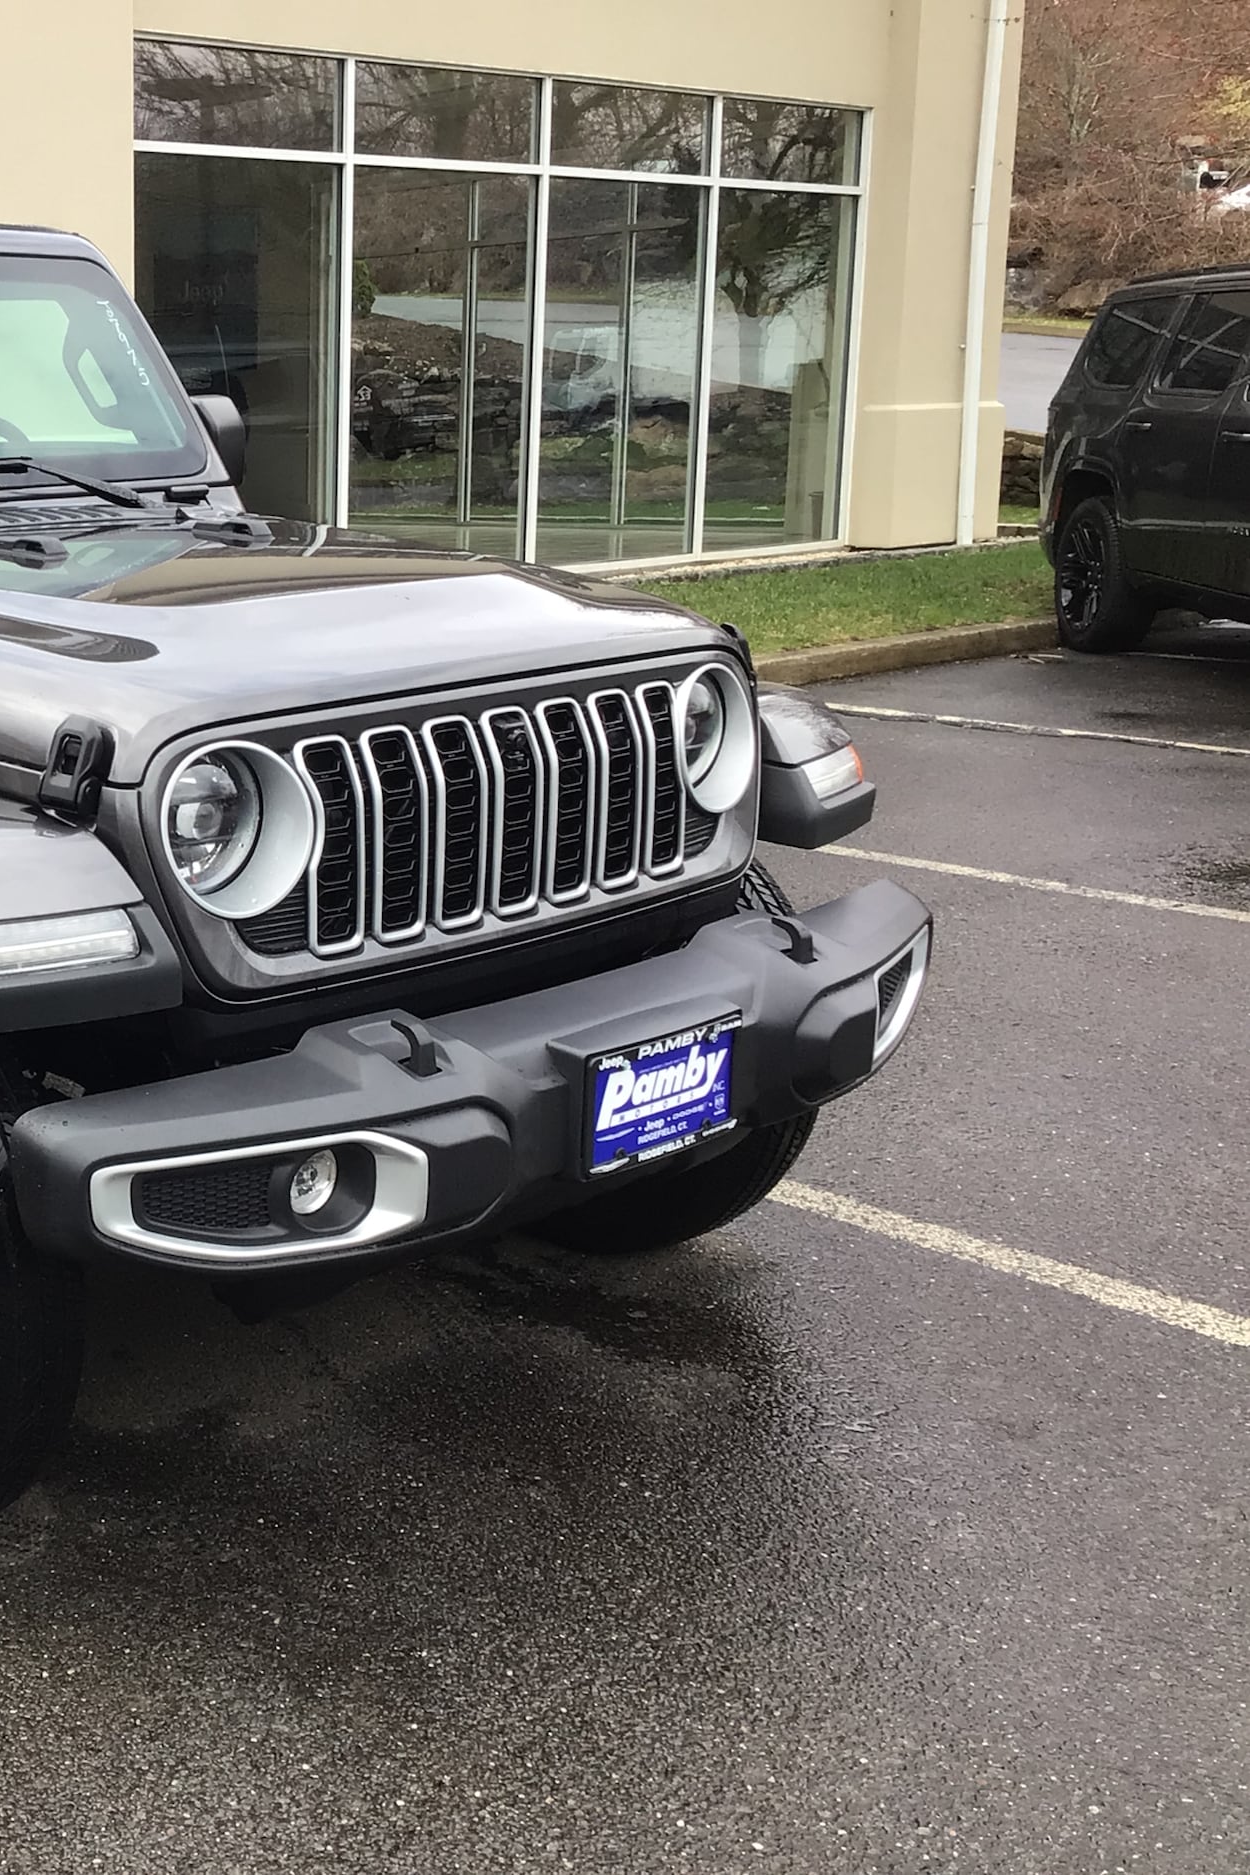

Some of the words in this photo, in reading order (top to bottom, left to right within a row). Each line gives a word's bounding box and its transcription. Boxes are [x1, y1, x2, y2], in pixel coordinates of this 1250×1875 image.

[599, 1055, 624, 1071] Jeep
[637, 1027, 708, 1060] PAMBY
[595, 1044, 728, 1132] Pamby
[644, 1118, 665, 1132] Jeep
